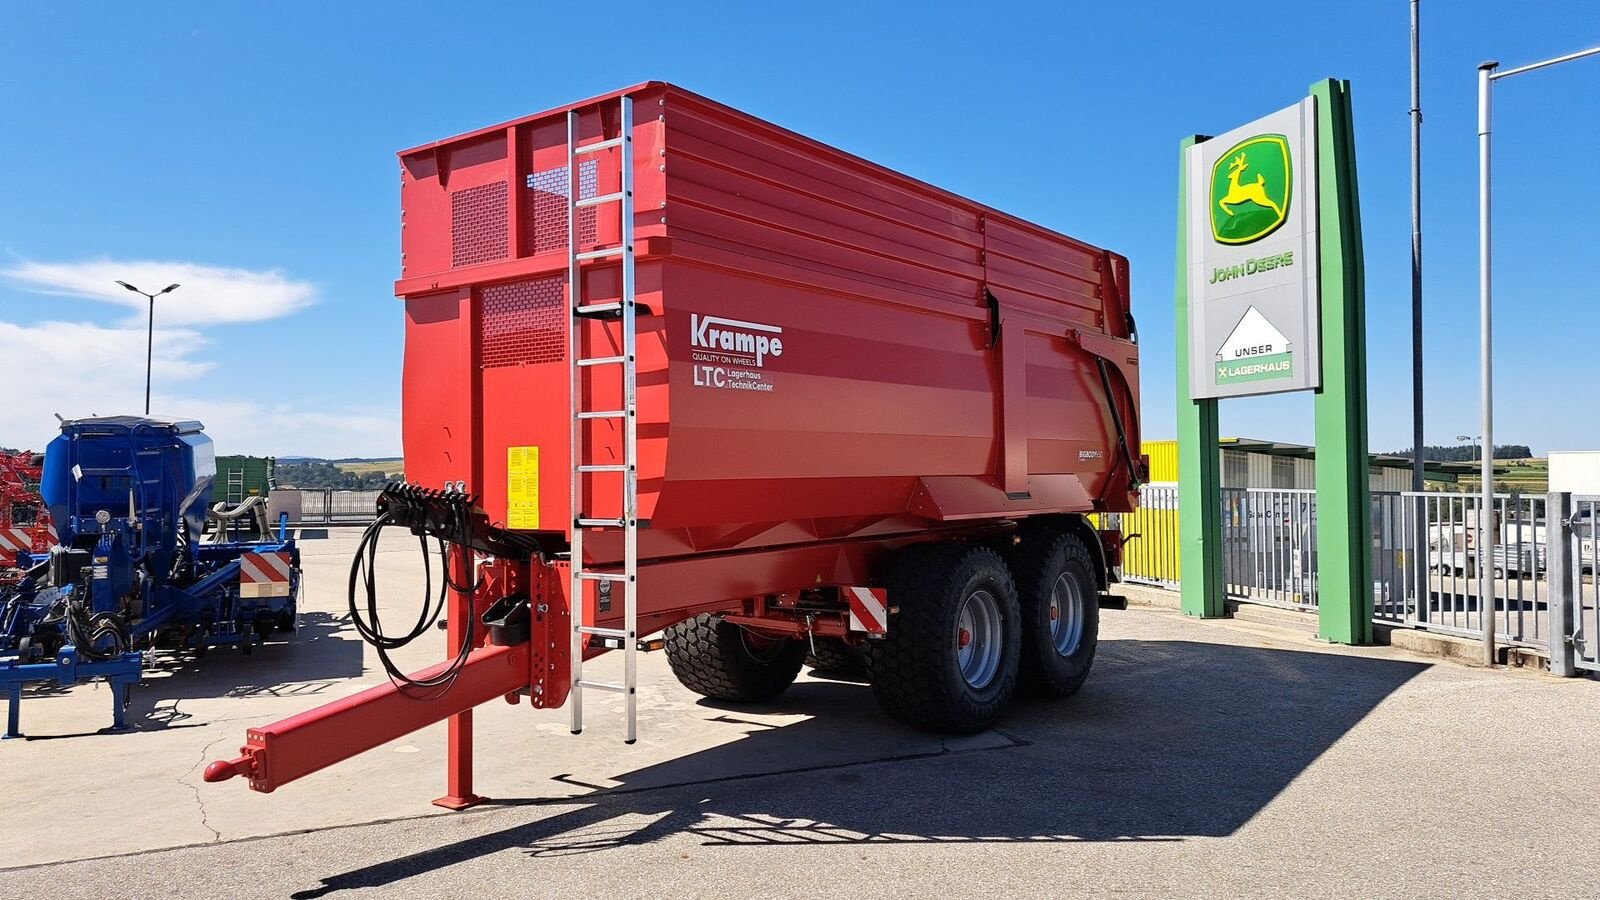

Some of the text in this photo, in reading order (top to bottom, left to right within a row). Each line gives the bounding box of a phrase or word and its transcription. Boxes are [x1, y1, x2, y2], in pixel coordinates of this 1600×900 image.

[1209, 251, 1294, 284] JOHN DEERE
[691, 314, 782, 367] Krampe
[1235, 344, 1273, 357] UNSER
[692, 353, 719, 363] QUALITY
[732, 358, 756, 366] WHEELS
[727, 370, 760, 380] Lagerhaus
[1228, 360, 1290, 377] LAGERHAUS
[693, 365, 725, 388] LTC
[727, 379, 773, 391] TechnikCenter
